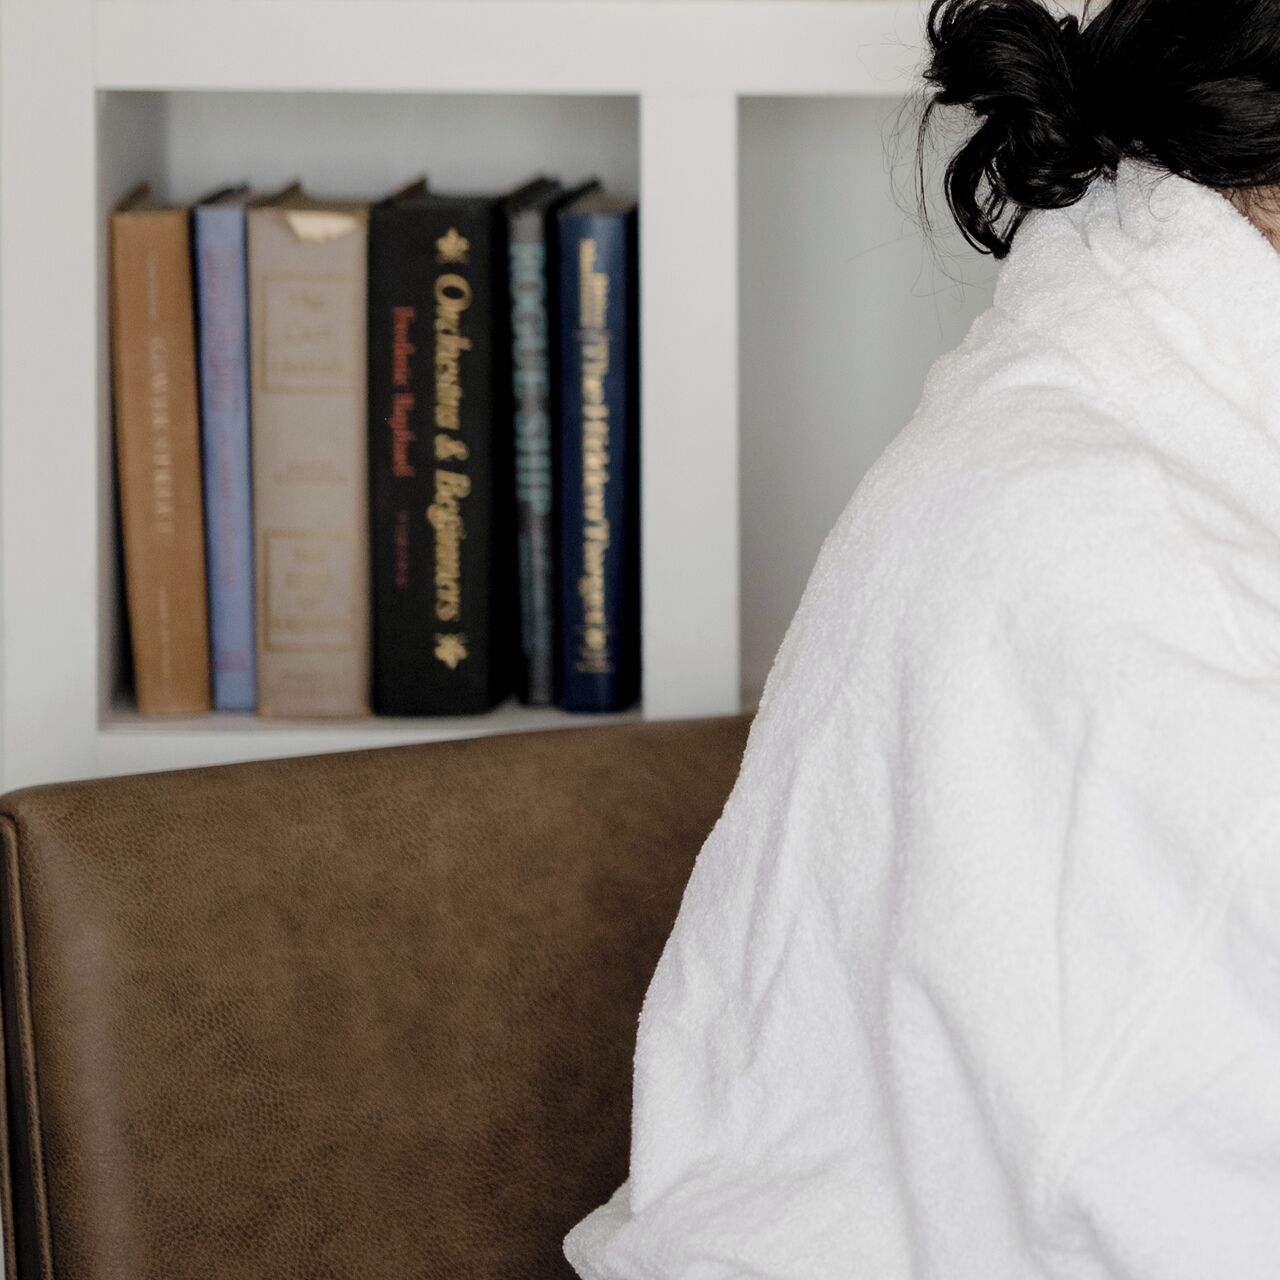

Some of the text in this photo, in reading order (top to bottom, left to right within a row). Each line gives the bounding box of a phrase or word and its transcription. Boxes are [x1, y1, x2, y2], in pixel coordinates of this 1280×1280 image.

[426, 272, 471, 621] Orchestra & Beginners
[516, 408, 551, 515] SHIP
